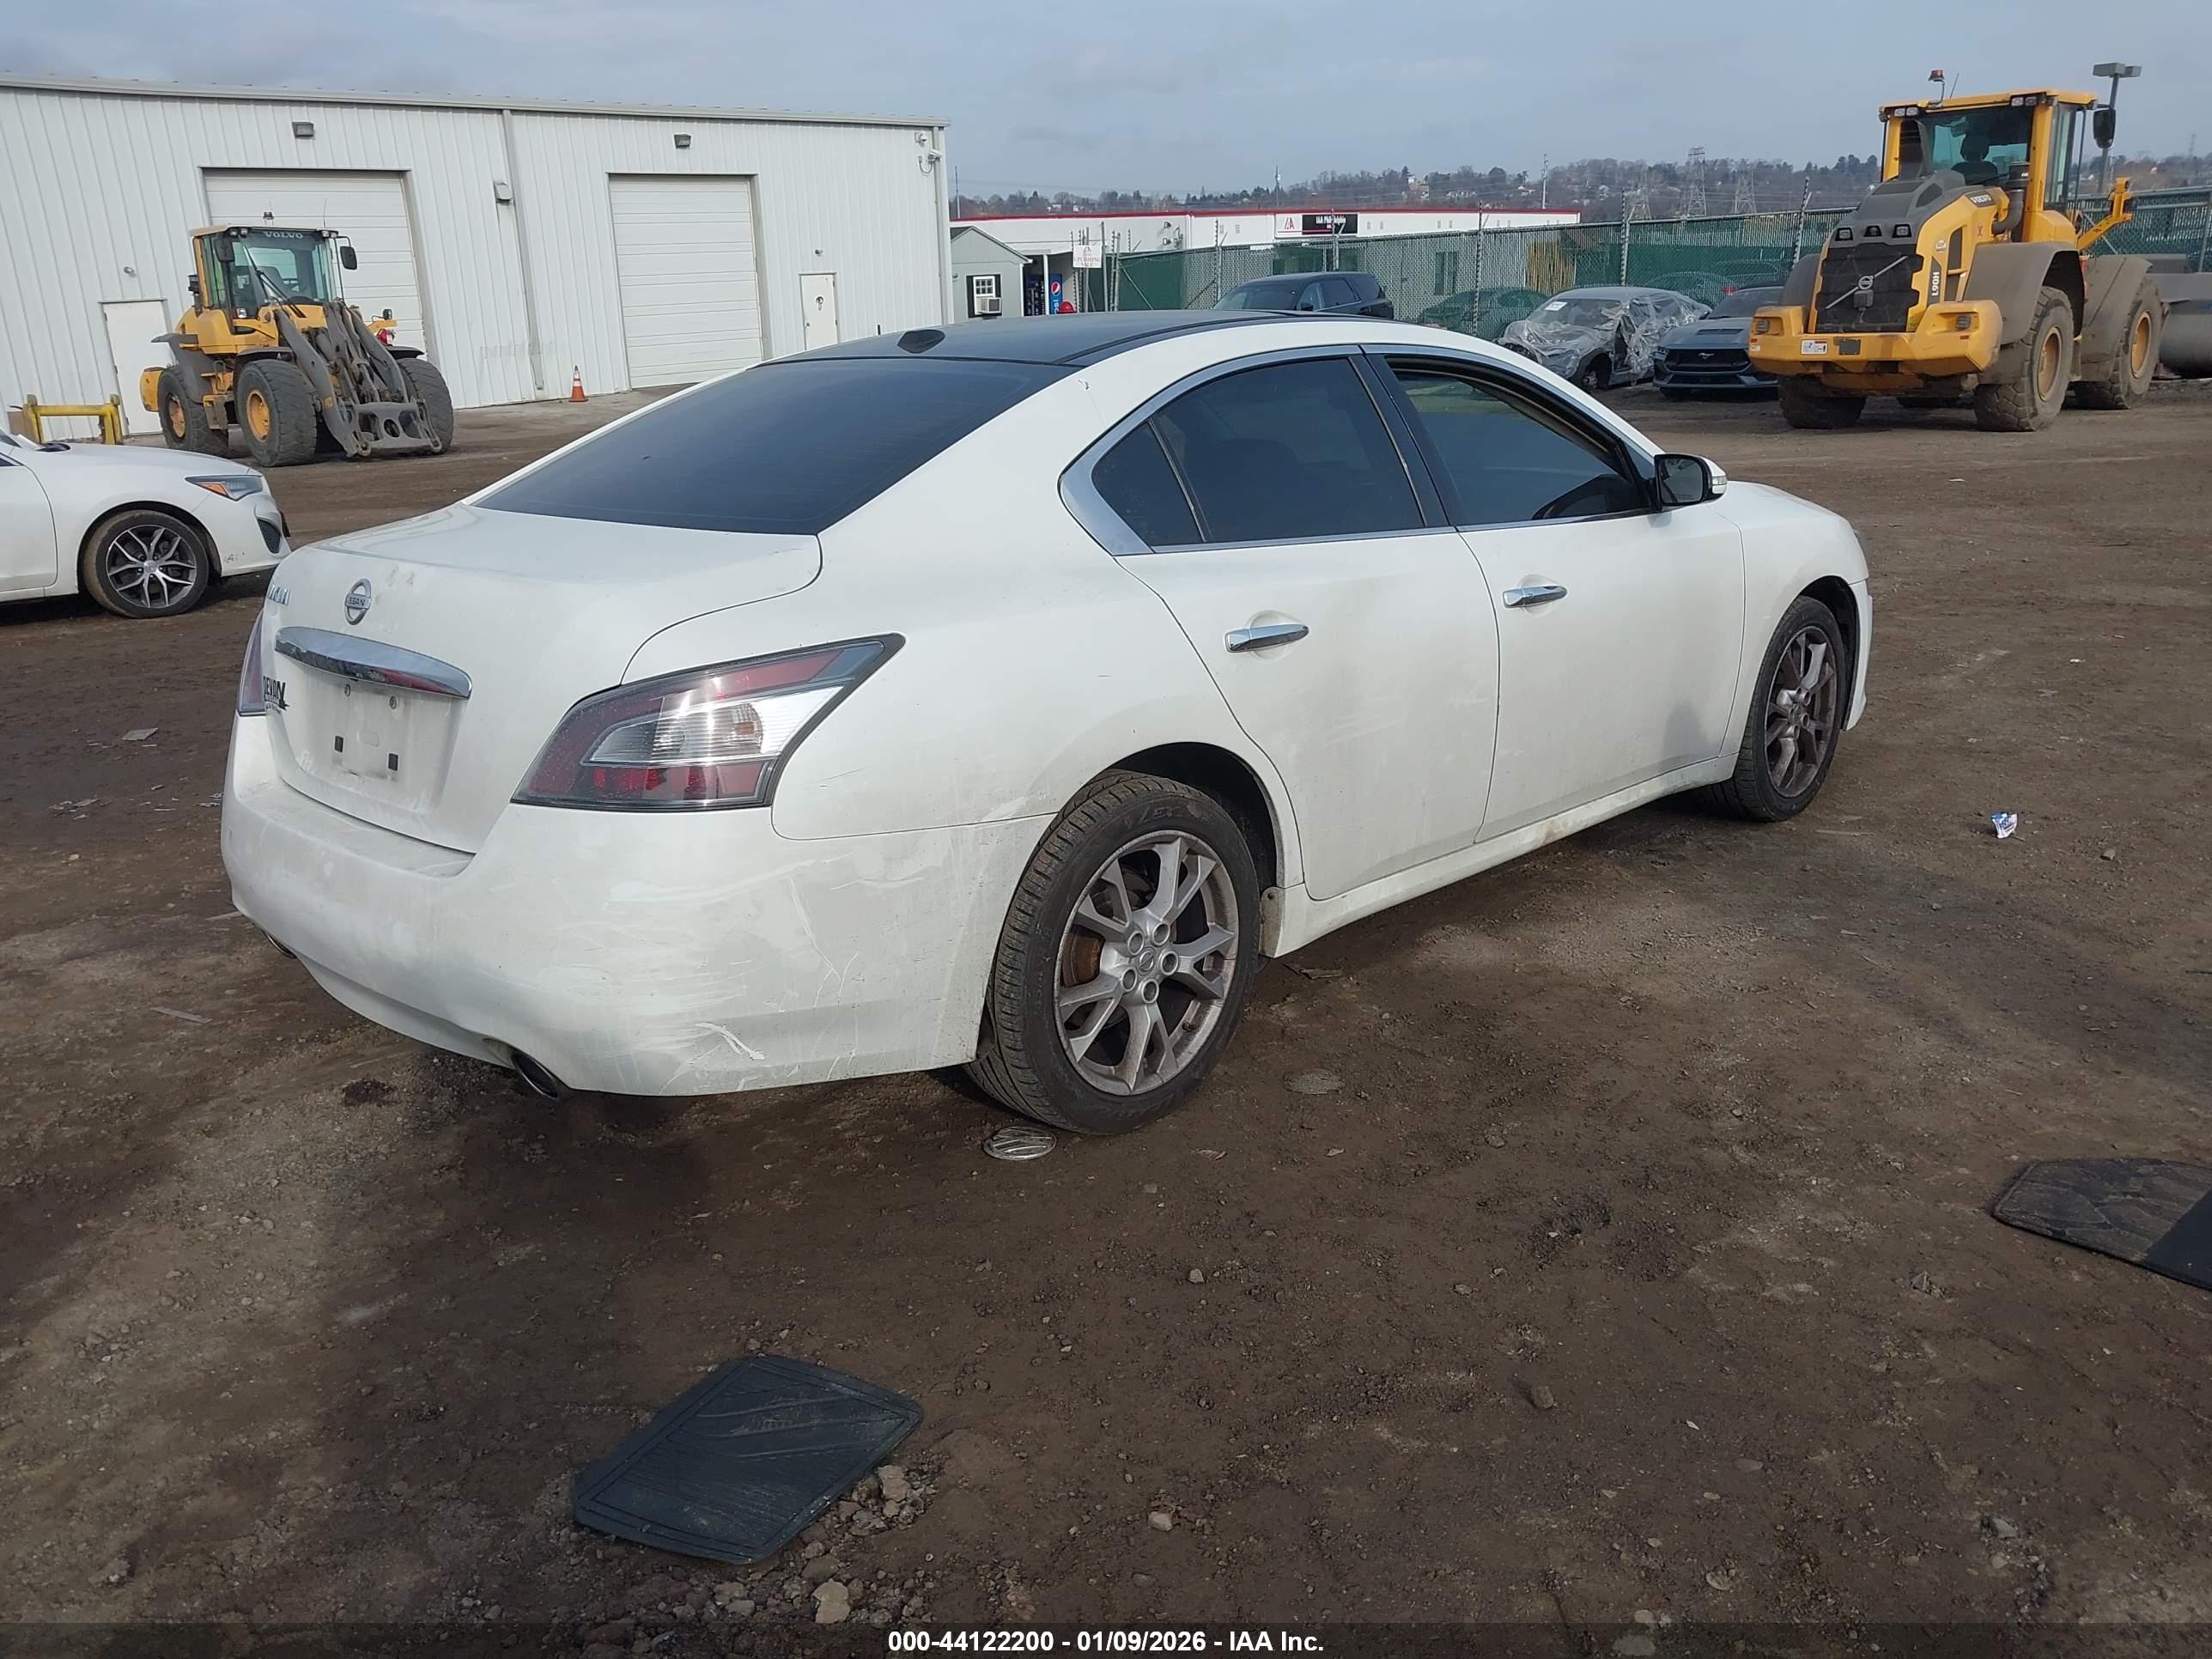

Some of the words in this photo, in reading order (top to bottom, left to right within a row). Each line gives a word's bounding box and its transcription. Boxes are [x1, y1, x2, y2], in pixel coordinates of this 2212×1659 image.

[1970, 194, 1992, 203] VOLVO
[264, 230, 304, 239] VOLVO
[1931, 271, 1940, 296] L90H
